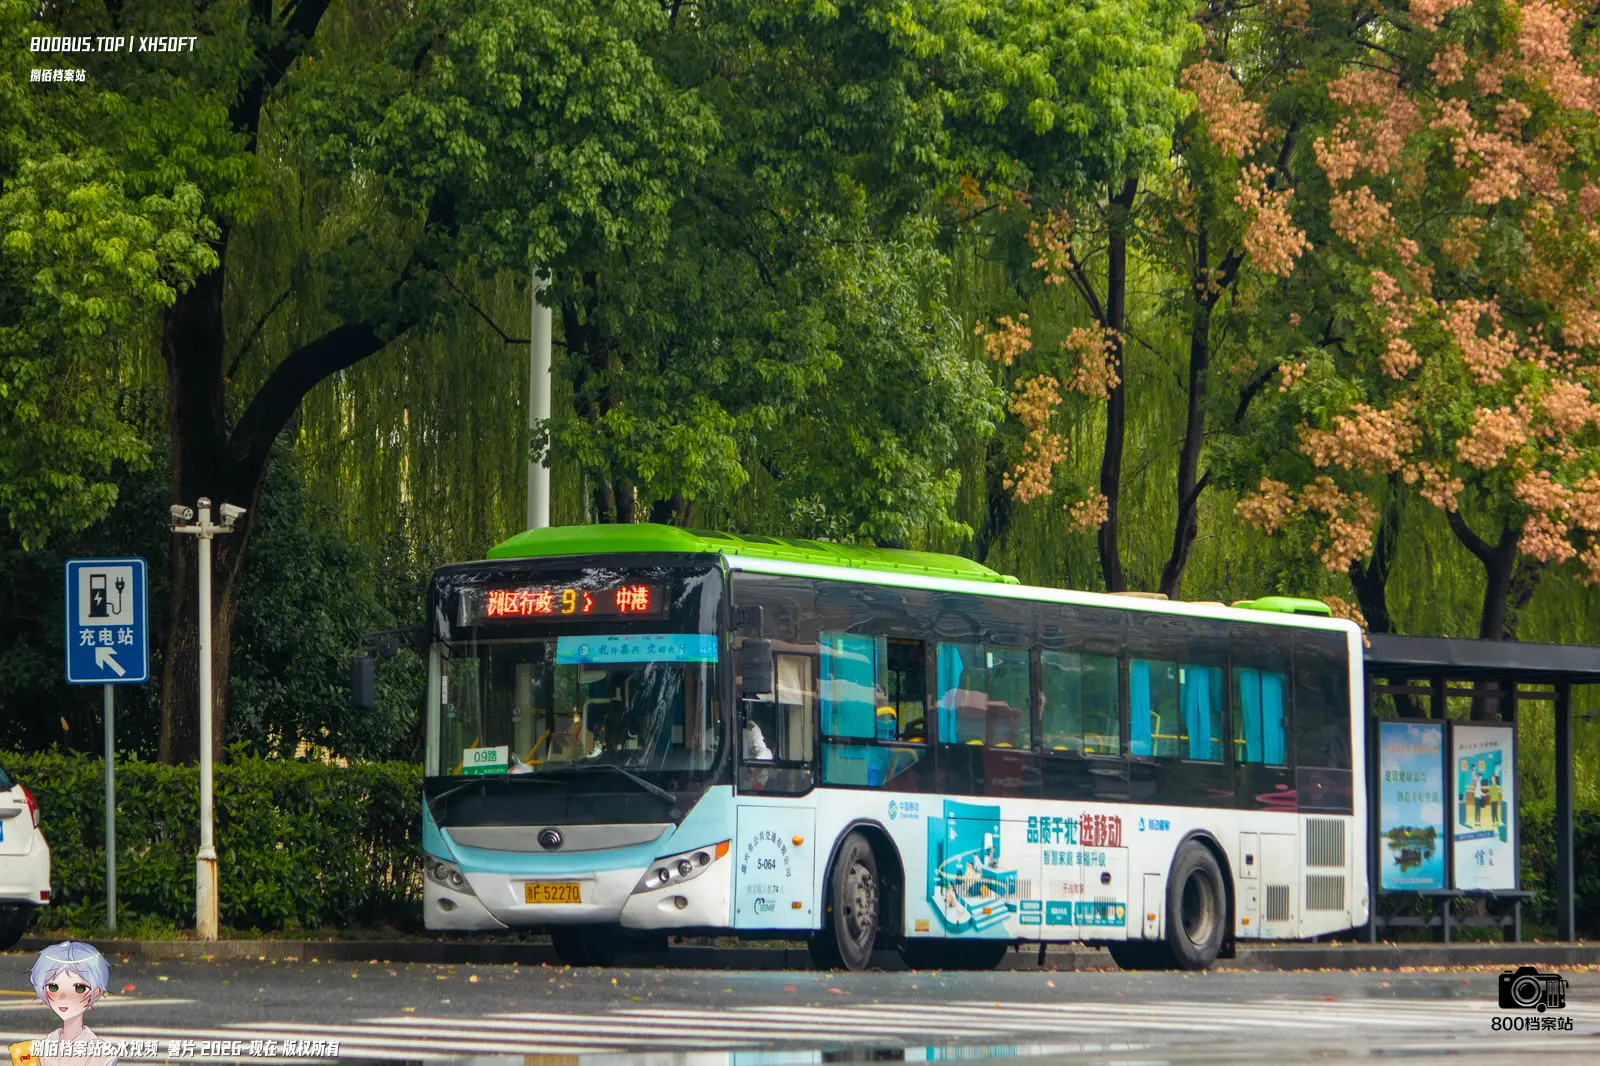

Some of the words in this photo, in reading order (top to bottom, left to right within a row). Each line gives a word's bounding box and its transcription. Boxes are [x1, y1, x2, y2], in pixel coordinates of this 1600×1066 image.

[562, 589, 576, 614] 9
[617, 587, 648, 612] 中港
[79, 627, 134, 647] 充电站
[474, 750, 497, 762] 09路
[757, 859, 776, 870] 5-064
[1043, 850, 1073, 866] 智慧家庭
